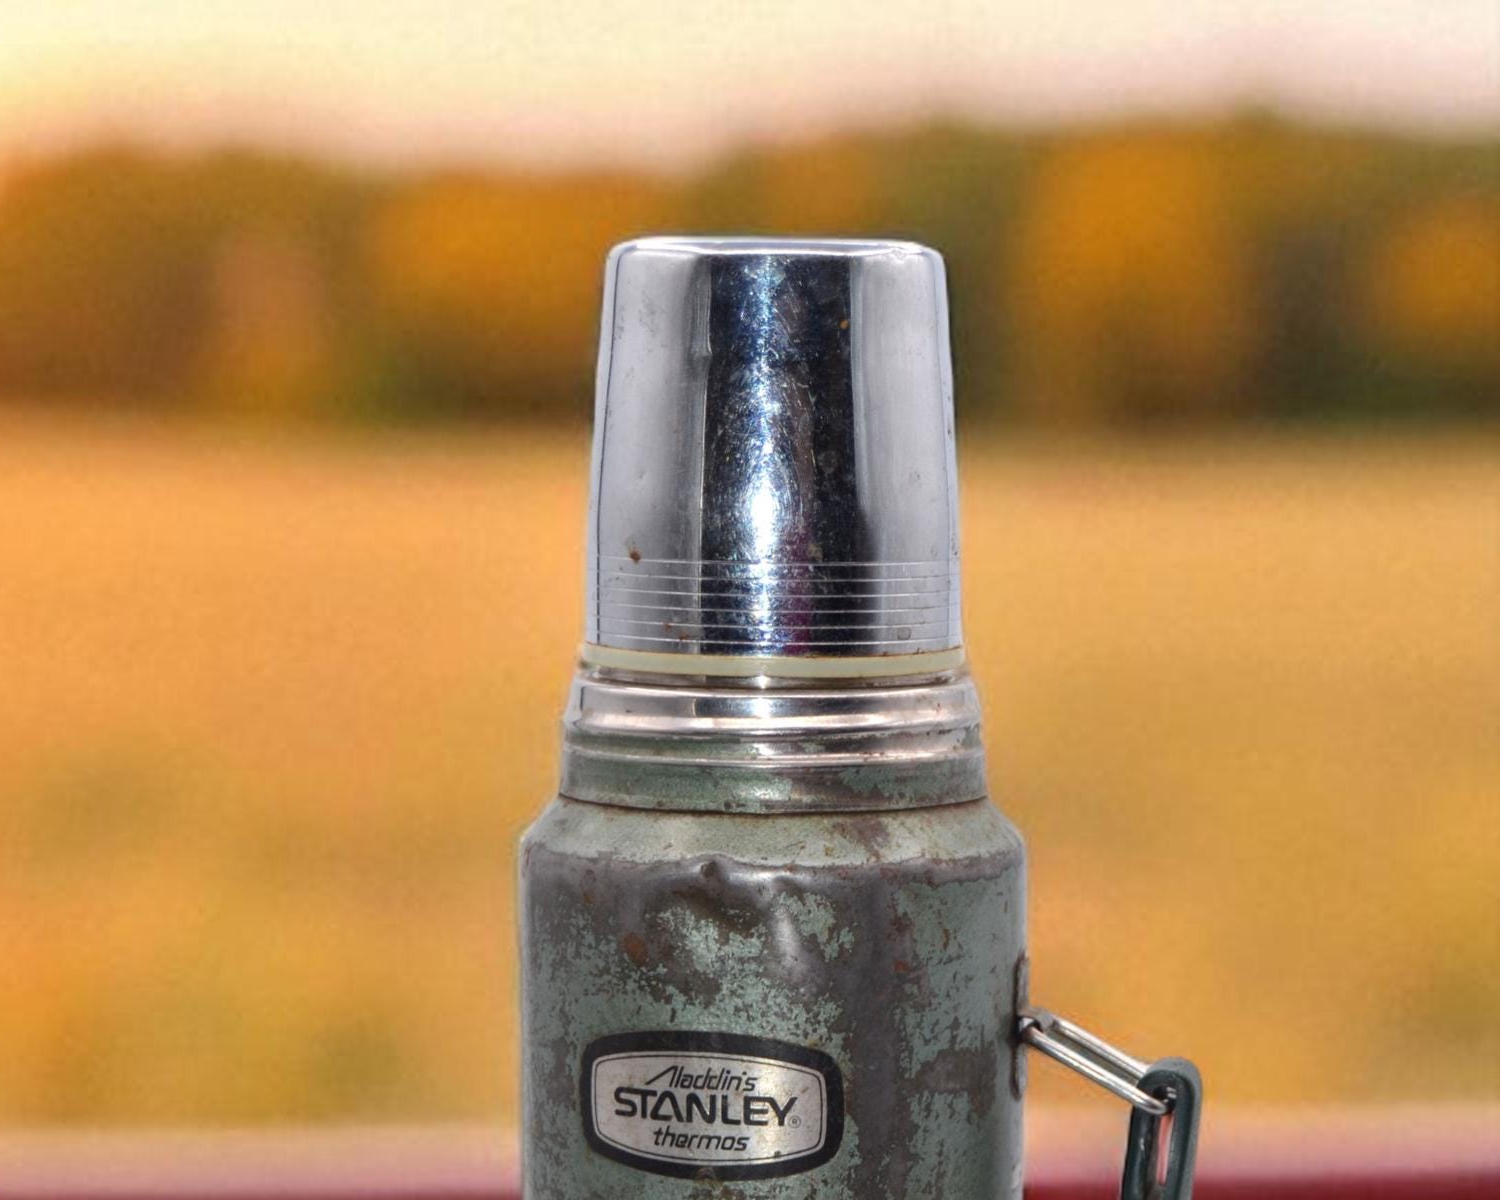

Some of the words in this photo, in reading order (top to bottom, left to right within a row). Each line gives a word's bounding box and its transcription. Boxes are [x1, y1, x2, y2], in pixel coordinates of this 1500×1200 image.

[645, 1065, 758, 1092] Aladdin's
[614, 1086, 799, 1127] STANLEY
[653, 1125, 750, 1151] thermos
